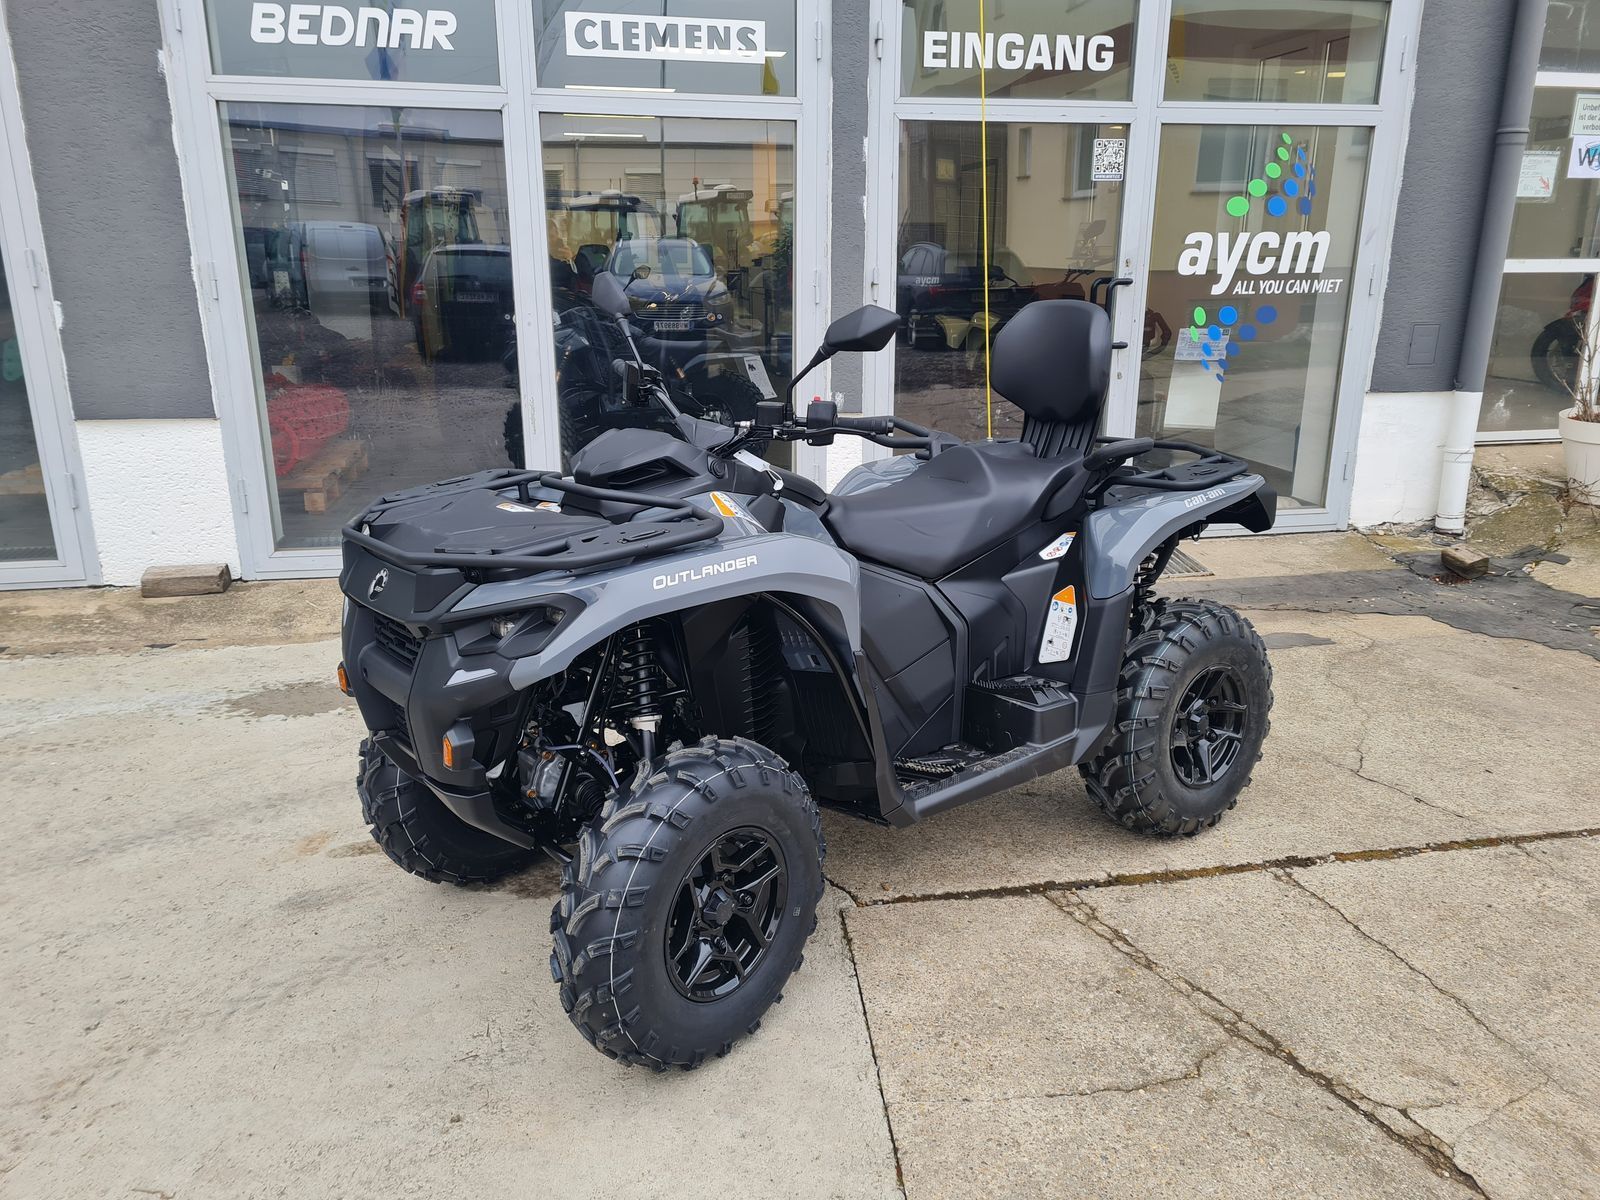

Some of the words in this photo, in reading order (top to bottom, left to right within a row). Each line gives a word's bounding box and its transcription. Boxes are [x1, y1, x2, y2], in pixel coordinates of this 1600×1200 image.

[250, 2, 457, 50] BEDNAR
[574, 18, 759, 57] CLEMENS
[923, 31, 1115, 71] EINGANG
[915, 276, 940, 287] aycm
[1177, 230, 1331, 296] aycm
[1232, 280, 1256, 295] ALL
[1259, 280, 1284, 295] YOU
[1285, 279, 1312, 294] CAN
[1311, 279, 1344, 294] MIET
[1184, 488, 1226, 508] can-am
[652, 555, 758, 590] OUTLANDER
